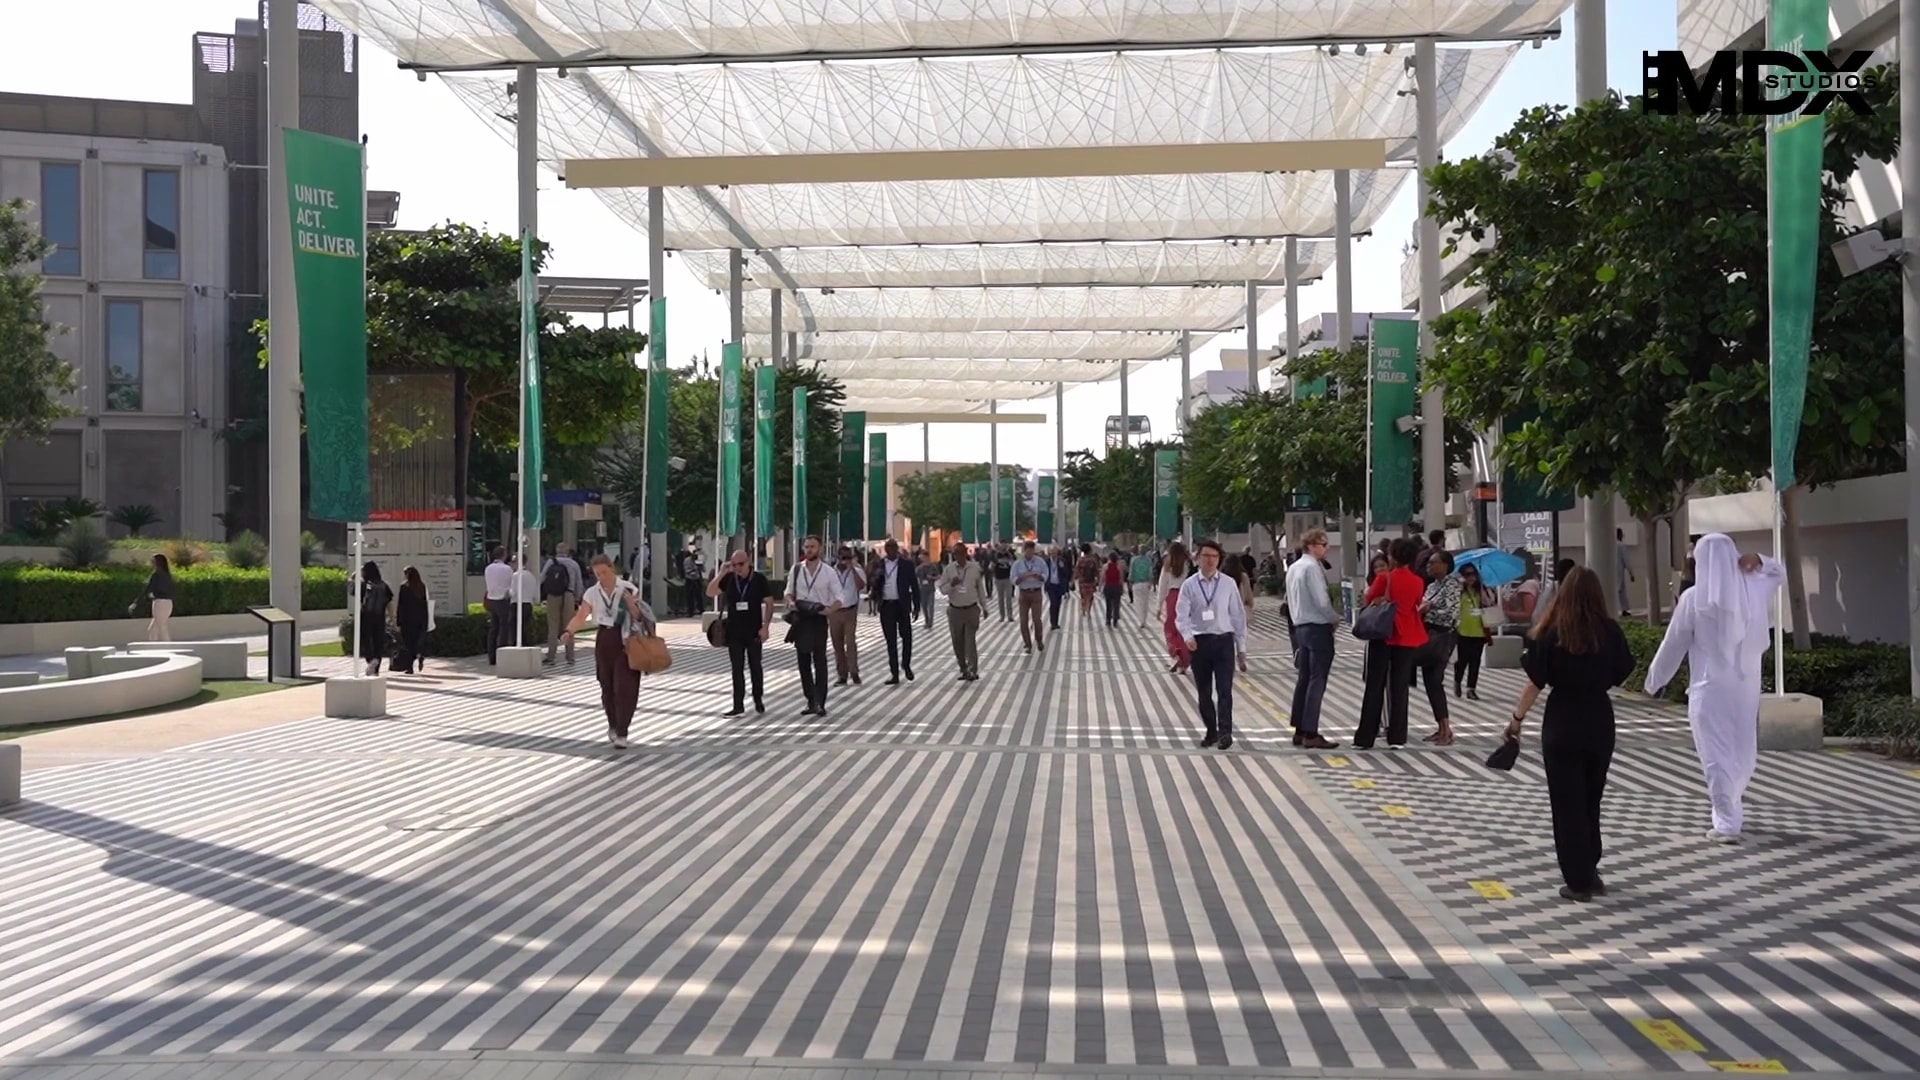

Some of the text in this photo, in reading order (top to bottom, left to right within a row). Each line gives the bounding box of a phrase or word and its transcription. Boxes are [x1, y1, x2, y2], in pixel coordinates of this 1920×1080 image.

[295, 184, 339, 209] UNITE.
[297, 208, 325, 229] ACT.
[298, 230, 360, 257] DELIVER.
